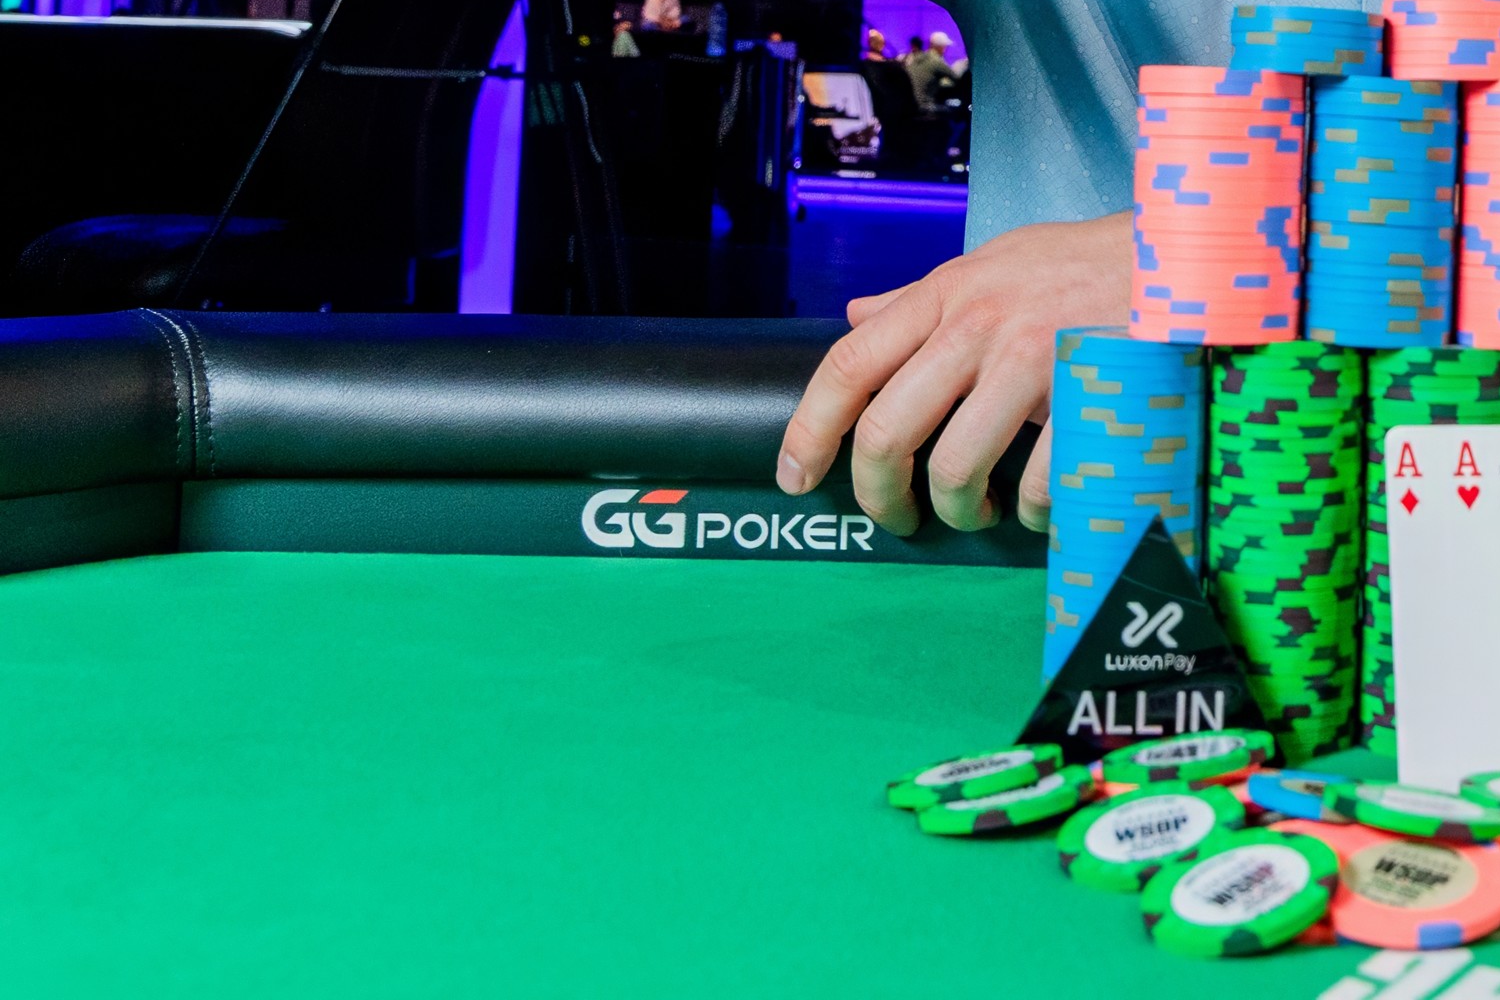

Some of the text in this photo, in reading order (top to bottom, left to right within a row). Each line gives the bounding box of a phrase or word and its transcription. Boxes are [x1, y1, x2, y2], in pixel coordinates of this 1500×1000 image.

[1395, 441, 1422, 477] A
[1454, 440, 1481, 476] A
[1105, 651, 1196, 675] LuxonPay
[1068, 690, 1225, 736] ALL IN
[1115, 814, 1187, 844] WSOP
